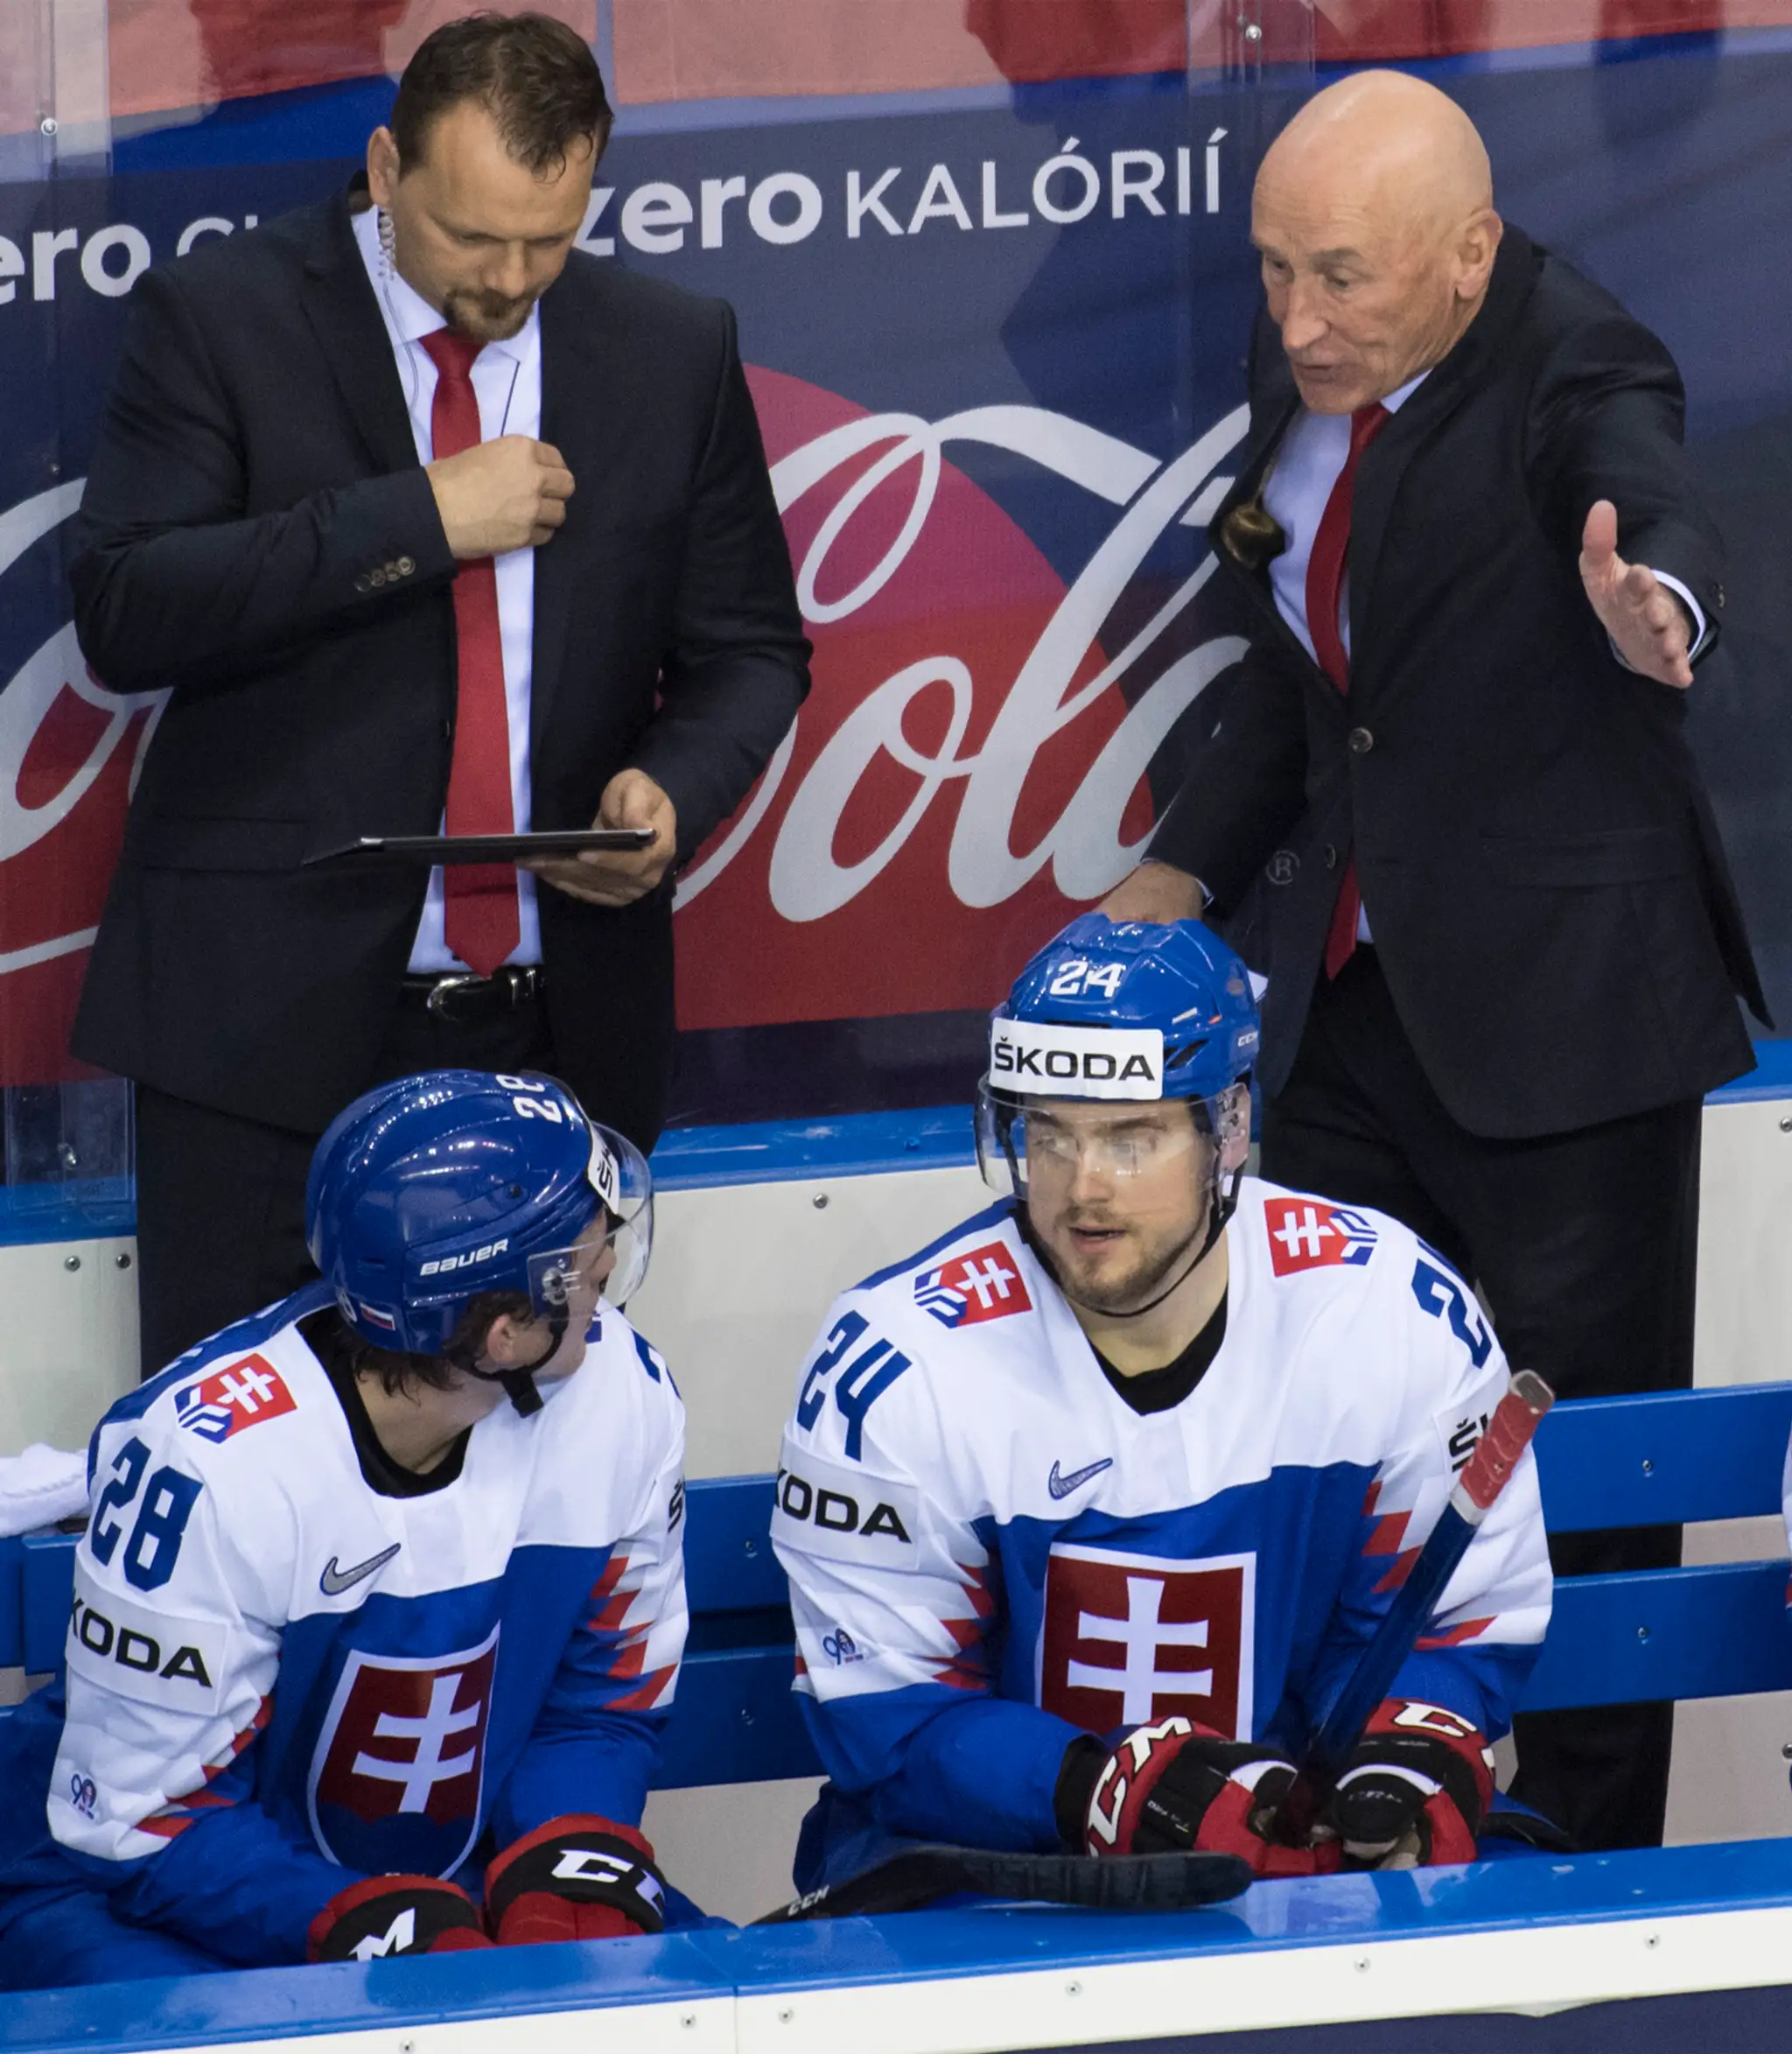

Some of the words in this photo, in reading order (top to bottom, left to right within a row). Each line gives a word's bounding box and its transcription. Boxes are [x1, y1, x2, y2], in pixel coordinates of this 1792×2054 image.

[846, 128, 1228, 238] KALÓRIÍ
[1050, 960, 1127, 998] 24
[993, 1036, 1156, 1082] ŠKODA
[796, 1309, 913, 1462] 24
[90, 1435, 205, 1593] 28
[788, 1883, 830, 1917] CCM
